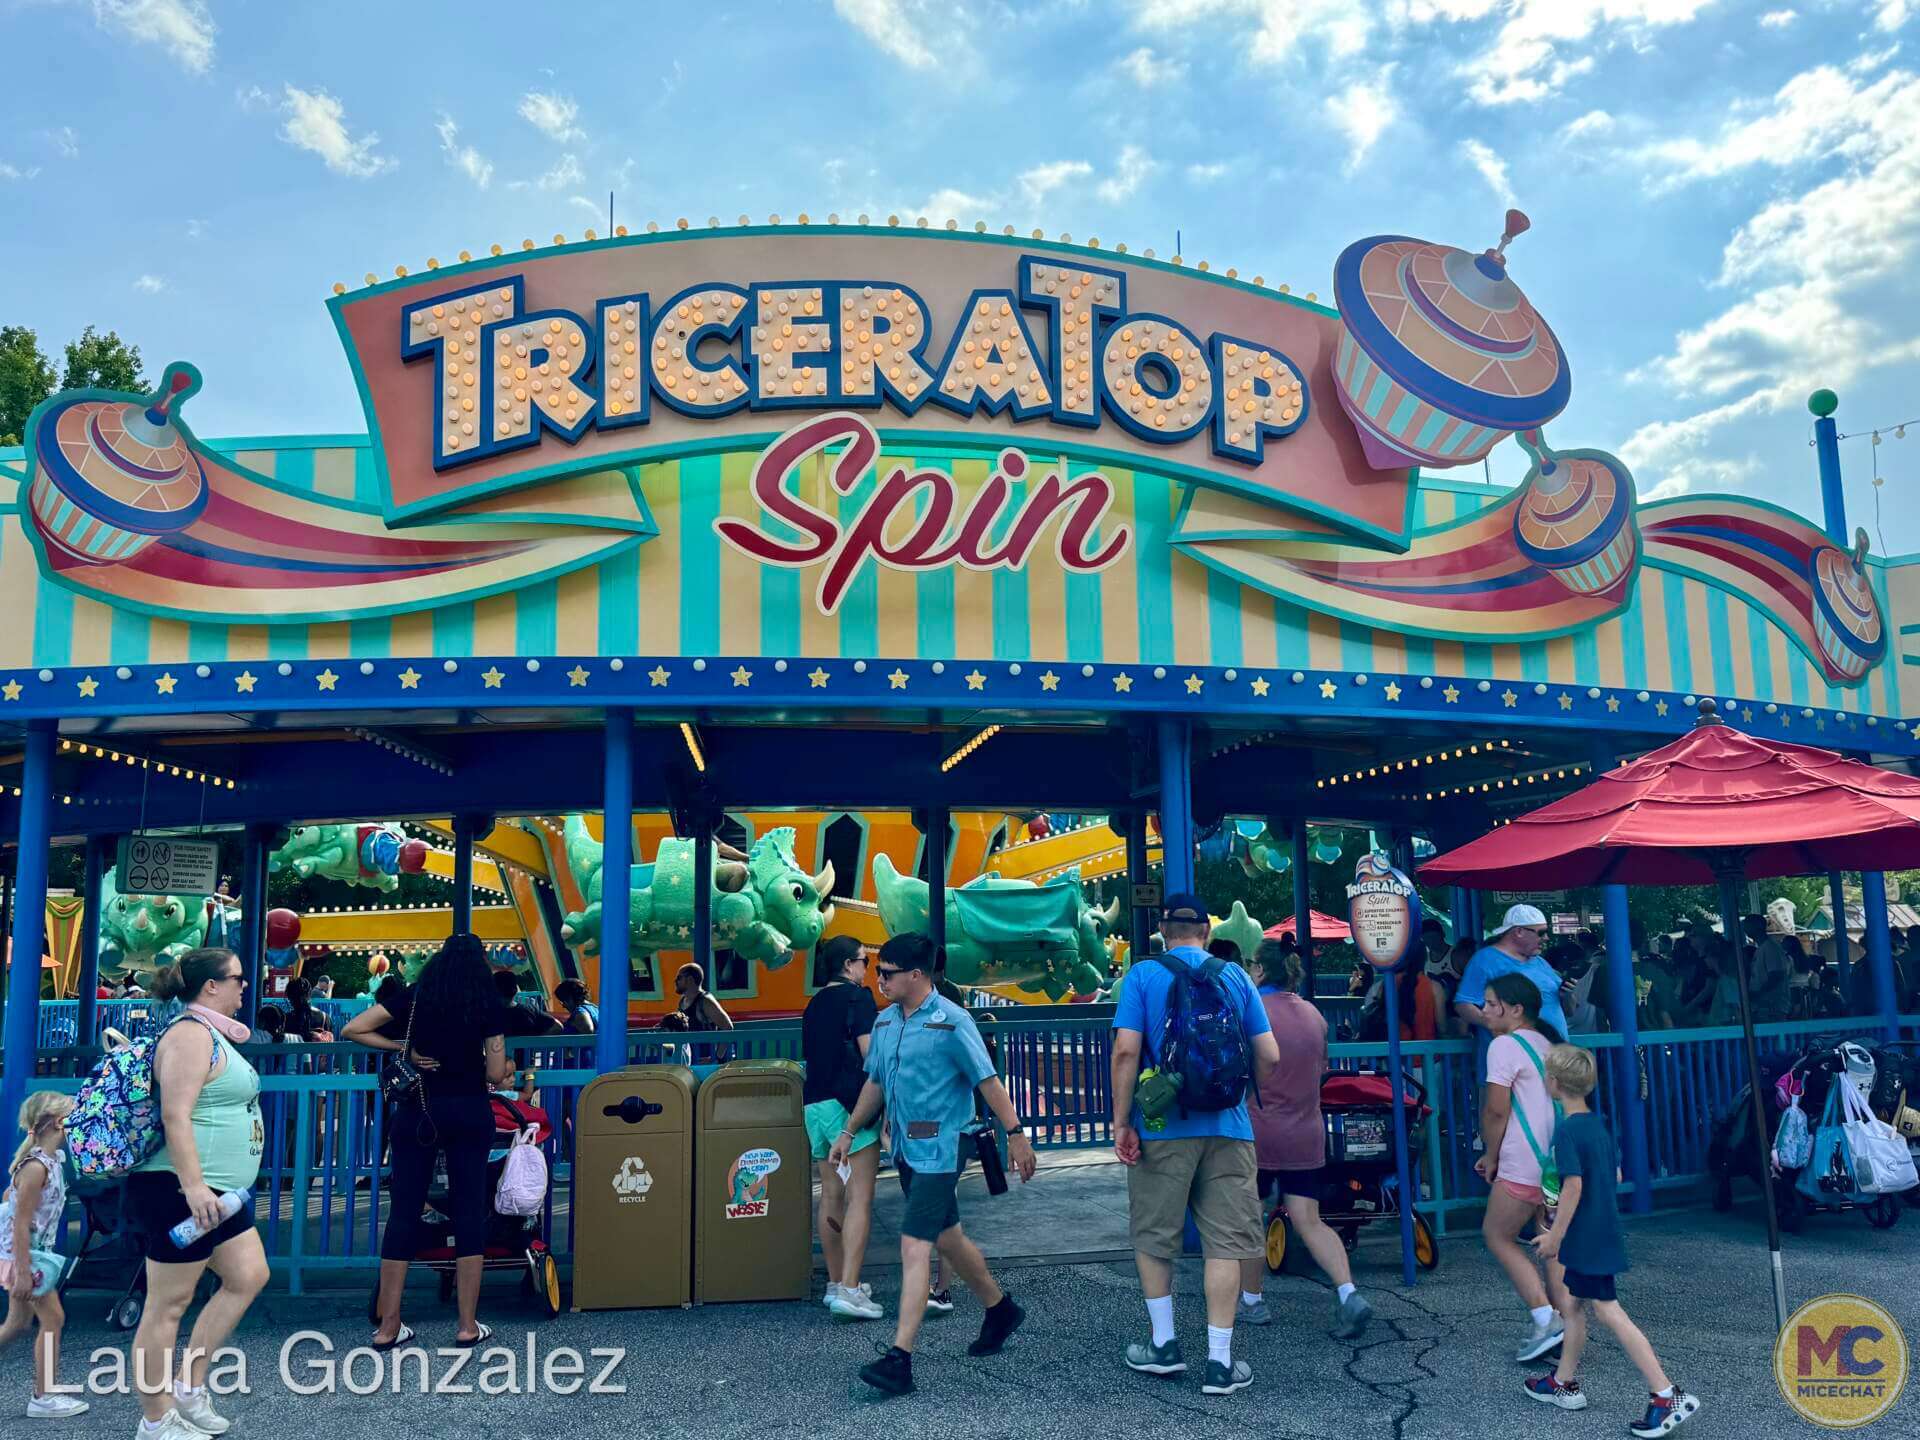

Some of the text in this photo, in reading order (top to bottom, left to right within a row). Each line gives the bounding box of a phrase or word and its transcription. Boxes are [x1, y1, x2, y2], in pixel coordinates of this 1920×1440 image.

[404, 256, 1309, 469] TRICERATOP
[713, 411, 1131, 616] Spin
[1345, 879, 1411, 899] TRICERATOP
[1367, 895, 1391, 907] Spin
